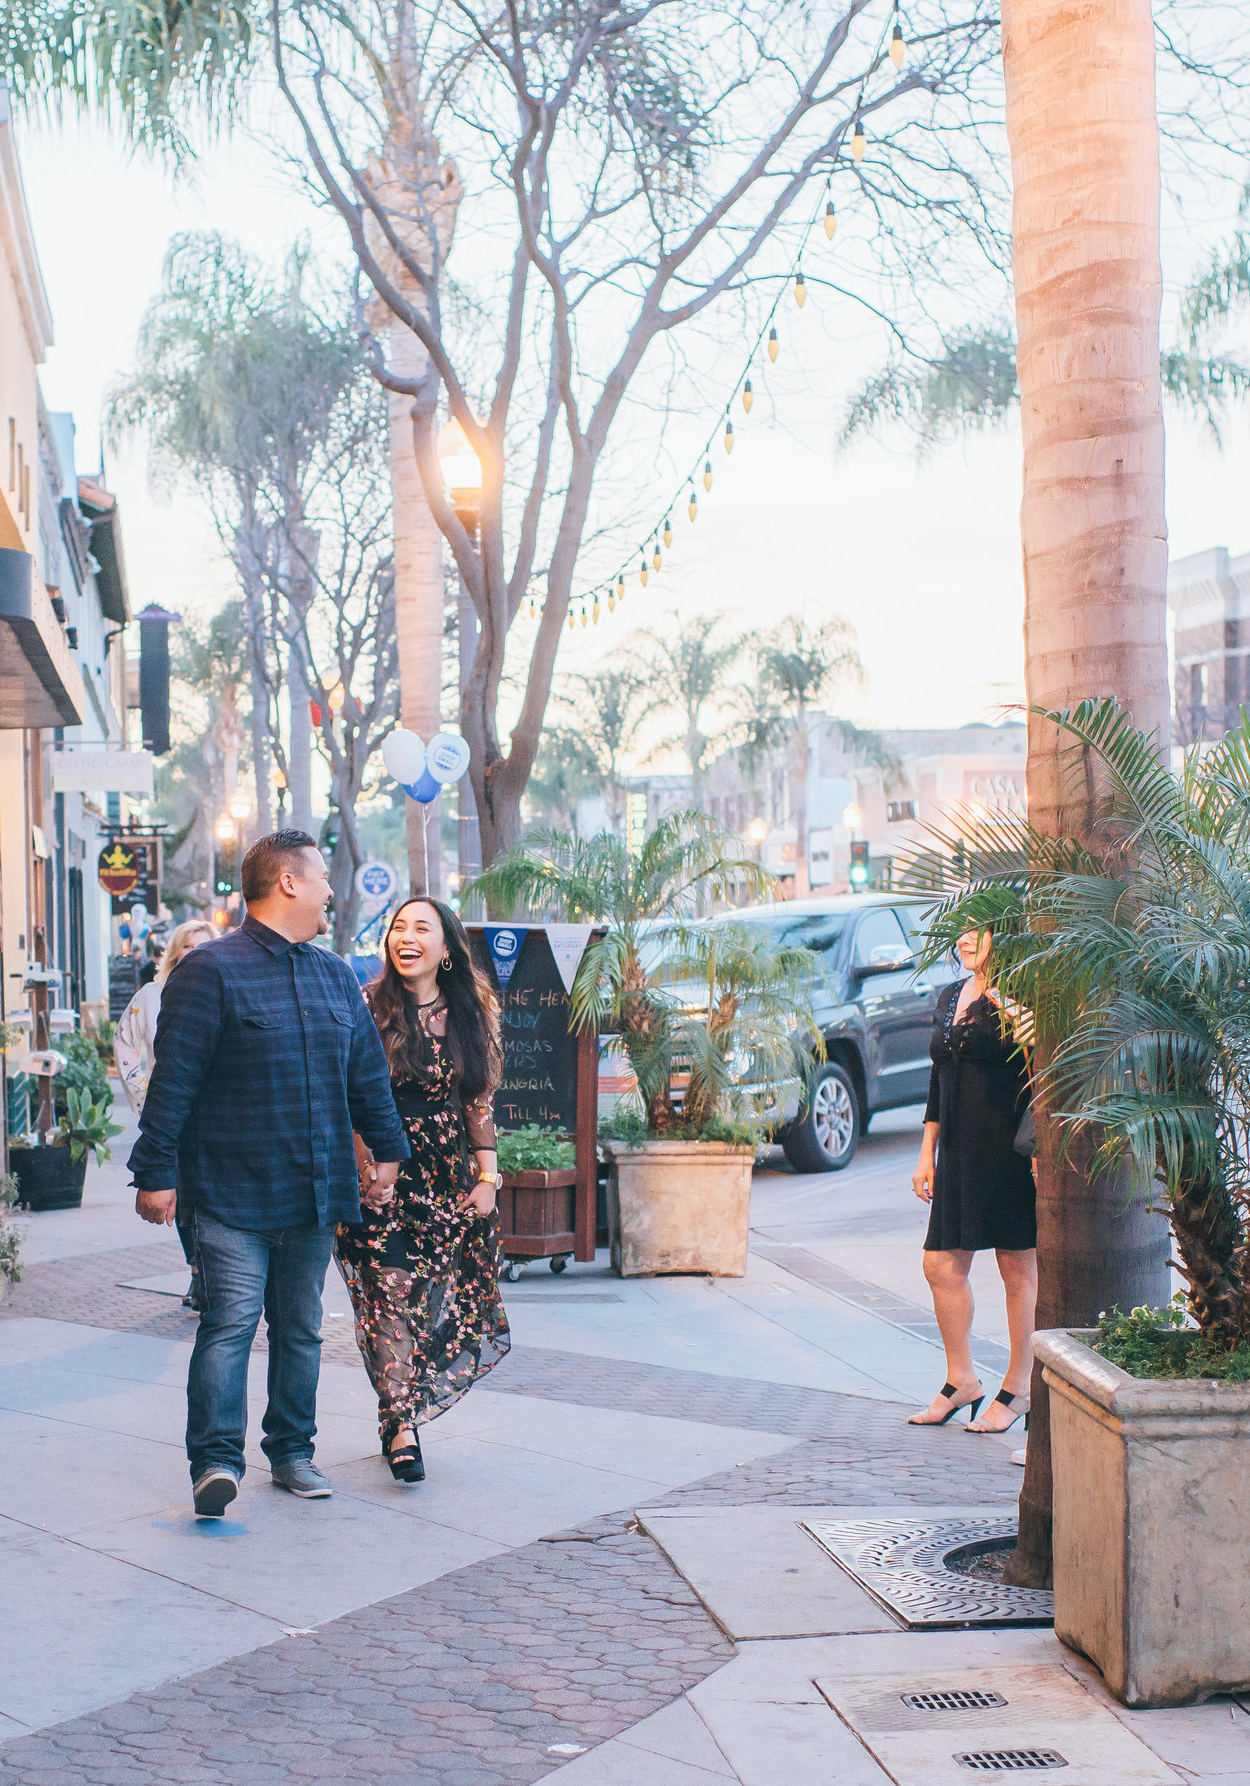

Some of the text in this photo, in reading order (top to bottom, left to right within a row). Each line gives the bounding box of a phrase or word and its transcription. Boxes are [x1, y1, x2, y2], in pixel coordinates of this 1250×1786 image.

[971, 775, 1018, 795] CASA
[364, 877, 389, 886] HERE
[366, 870, 385, 878] PAY
[502, 1010, 541, 1029] NJOY
[500, 1076, 556, 1091] ANGRIA
